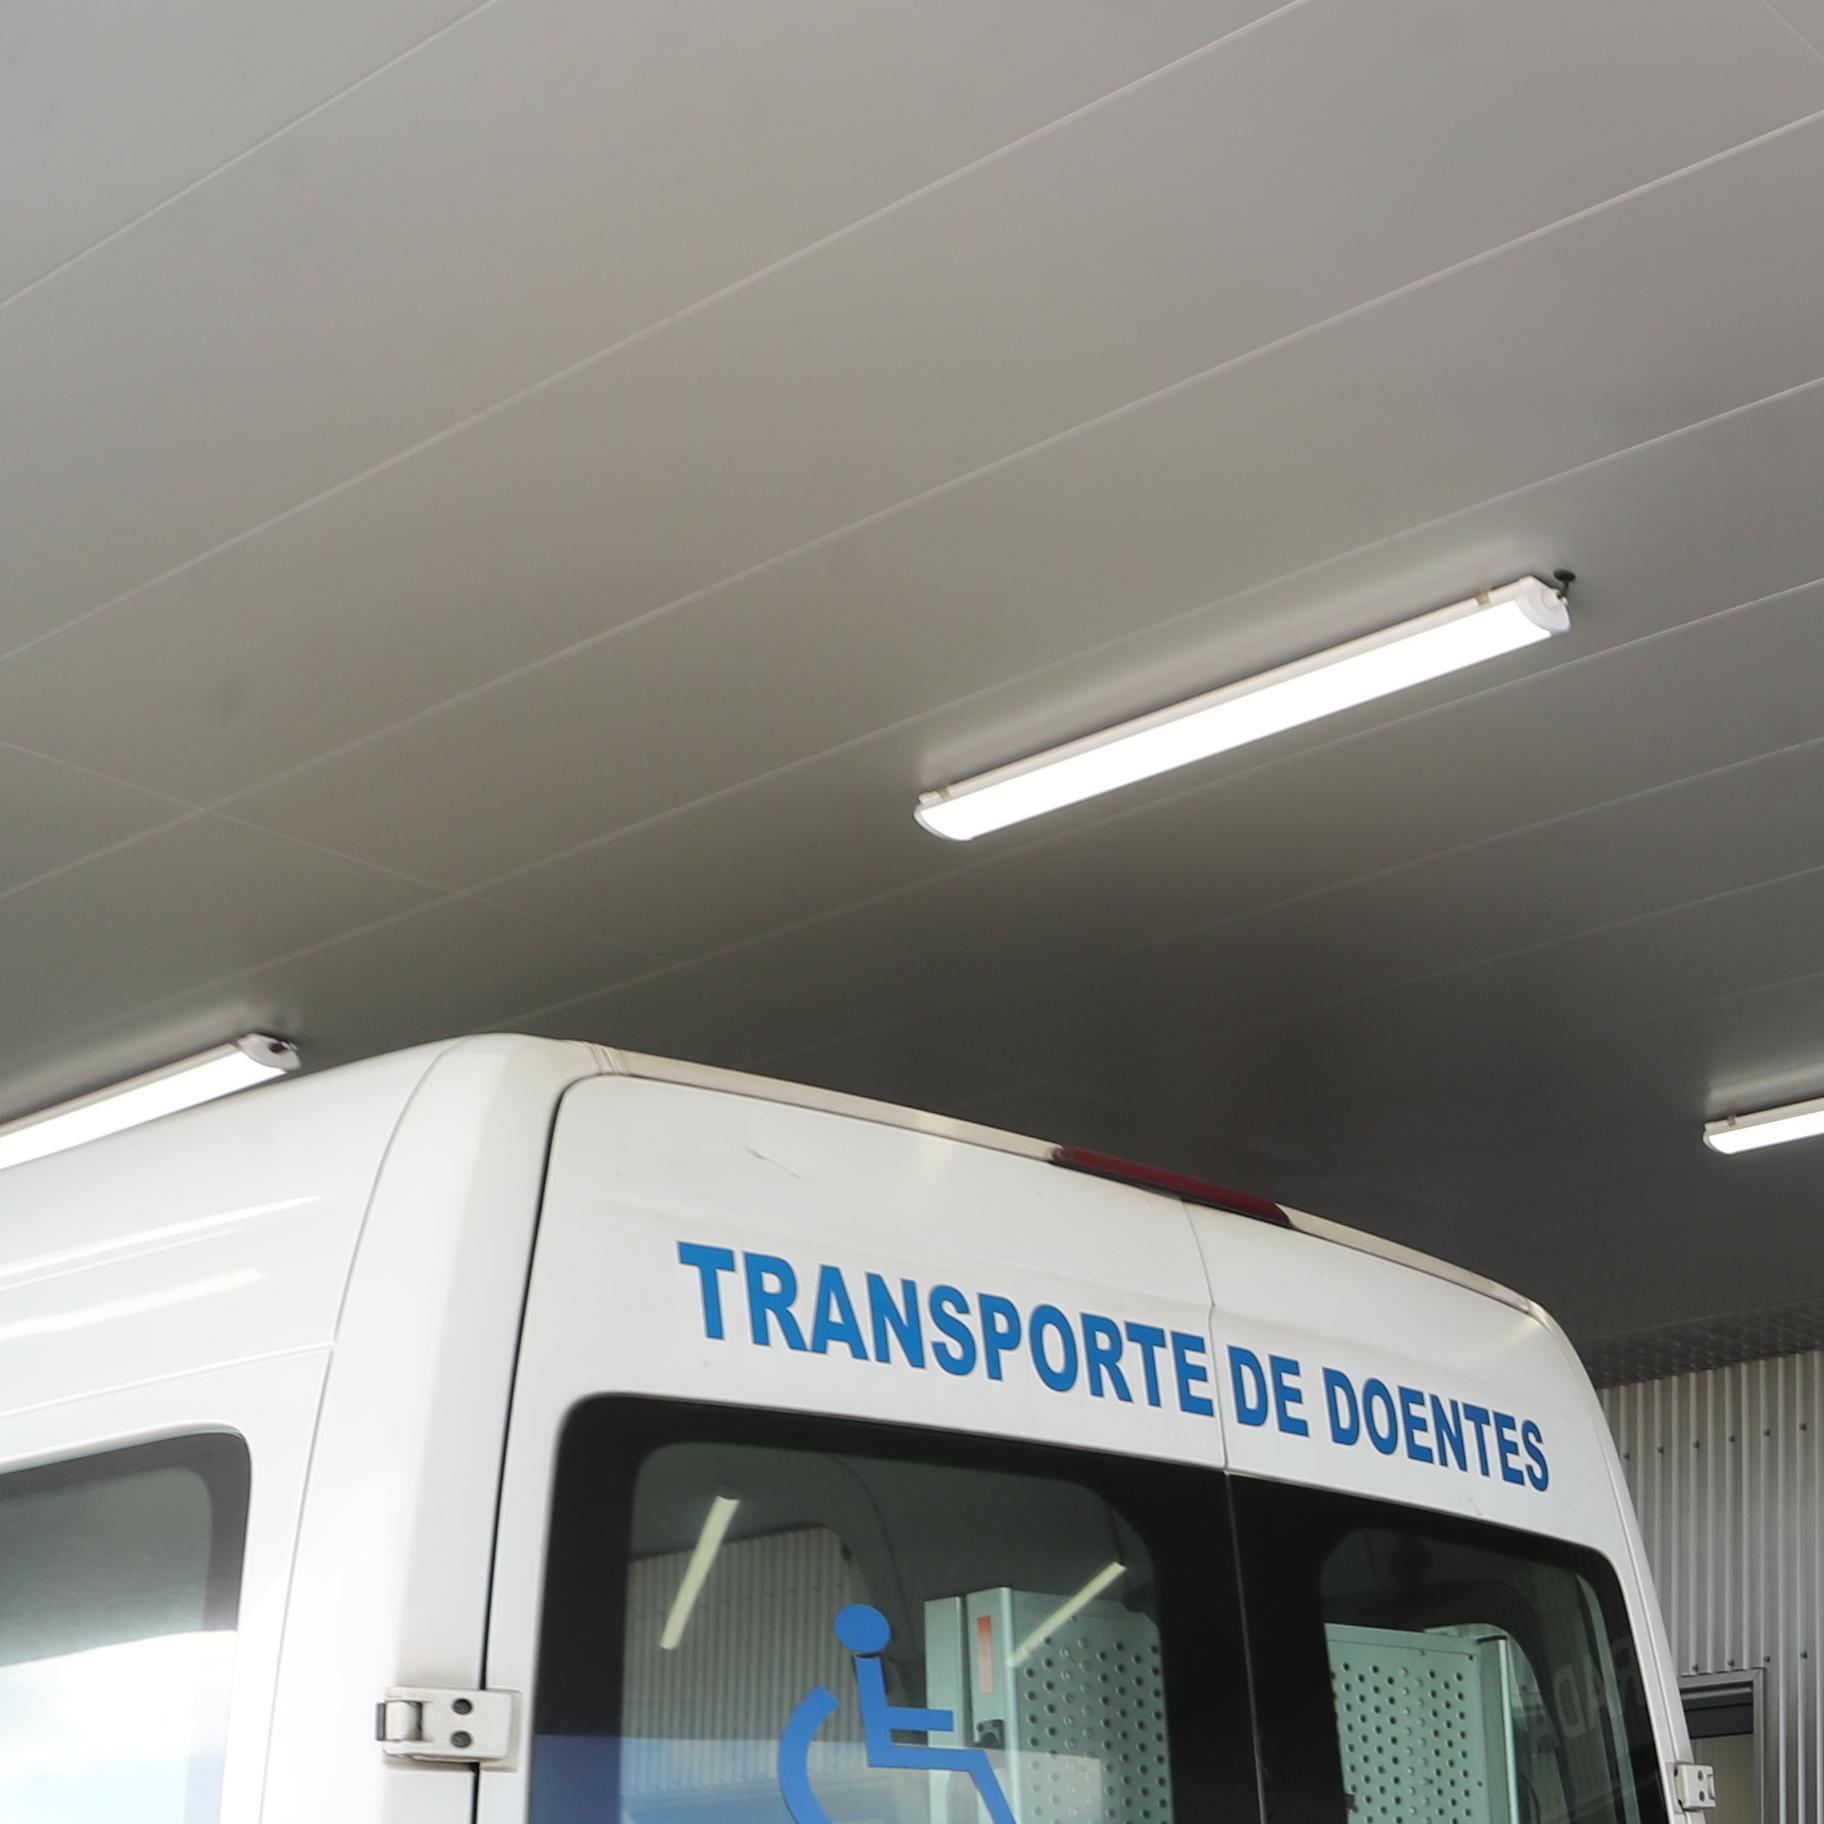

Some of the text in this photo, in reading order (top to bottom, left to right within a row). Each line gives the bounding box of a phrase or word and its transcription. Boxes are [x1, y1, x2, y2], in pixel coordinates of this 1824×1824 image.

[677, 1240, 1549, 1491] TRANSPORTE DE DOENTES
